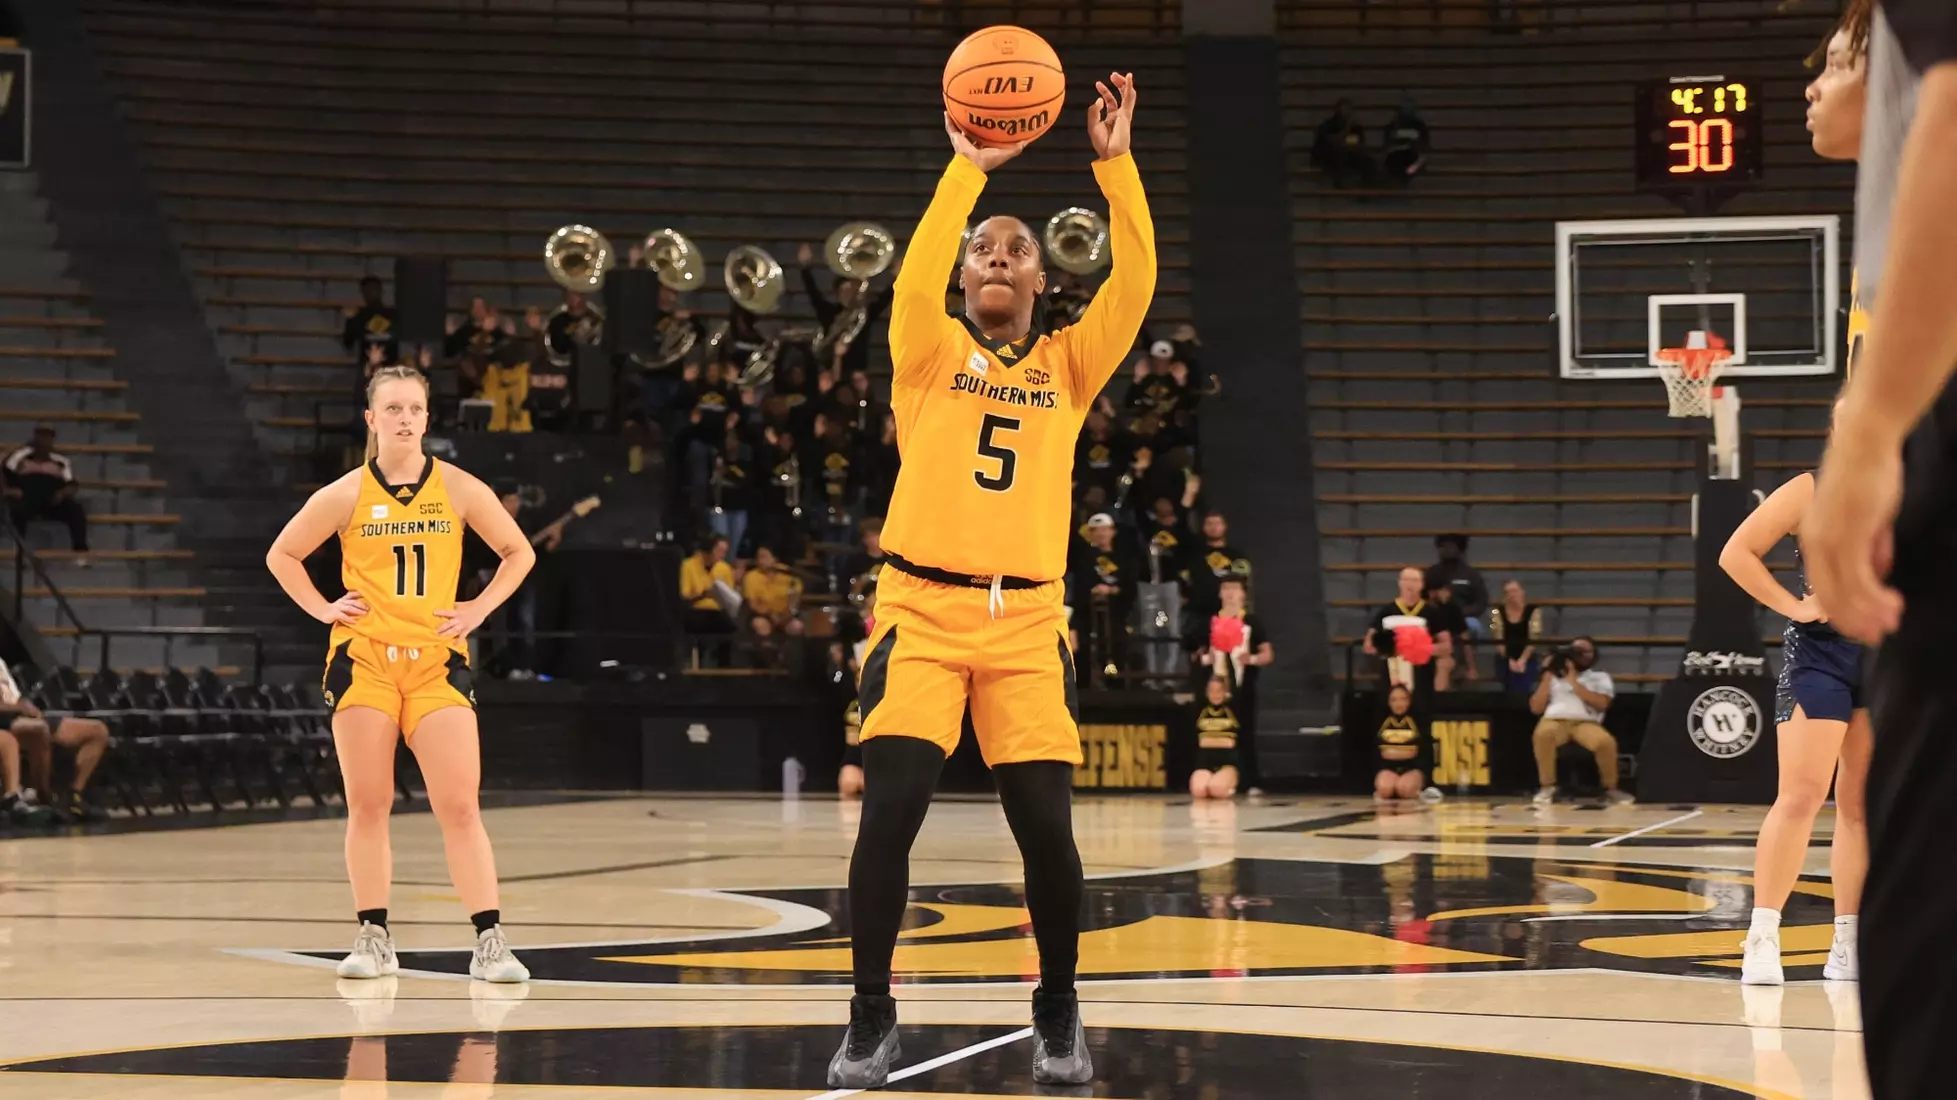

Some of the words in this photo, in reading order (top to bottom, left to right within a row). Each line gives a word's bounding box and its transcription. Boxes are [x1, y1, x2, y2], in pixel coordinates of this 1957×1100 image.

[983, 76, 1034, 95] EVO
[1671, 83, 1747, 114] 4:17
[968, 110, 1049, 136] Wilson
[1668, 118, 1733, 173] 30
[950, 373, 1027, 406] SOUTHERN
[1030, 389, 1059, 409] MIS
[1024, 367, 1051, 386] SBC
[973, 412, 1021, 493] 5
[419, 502, 443, 515] SBC
[360, 520, 425, 537] SOUTHERN
[427, 519, 451, 534] MISS
[392, 544, 425, 597] 11
[1073, 724, 1167, 788] EFENSE
